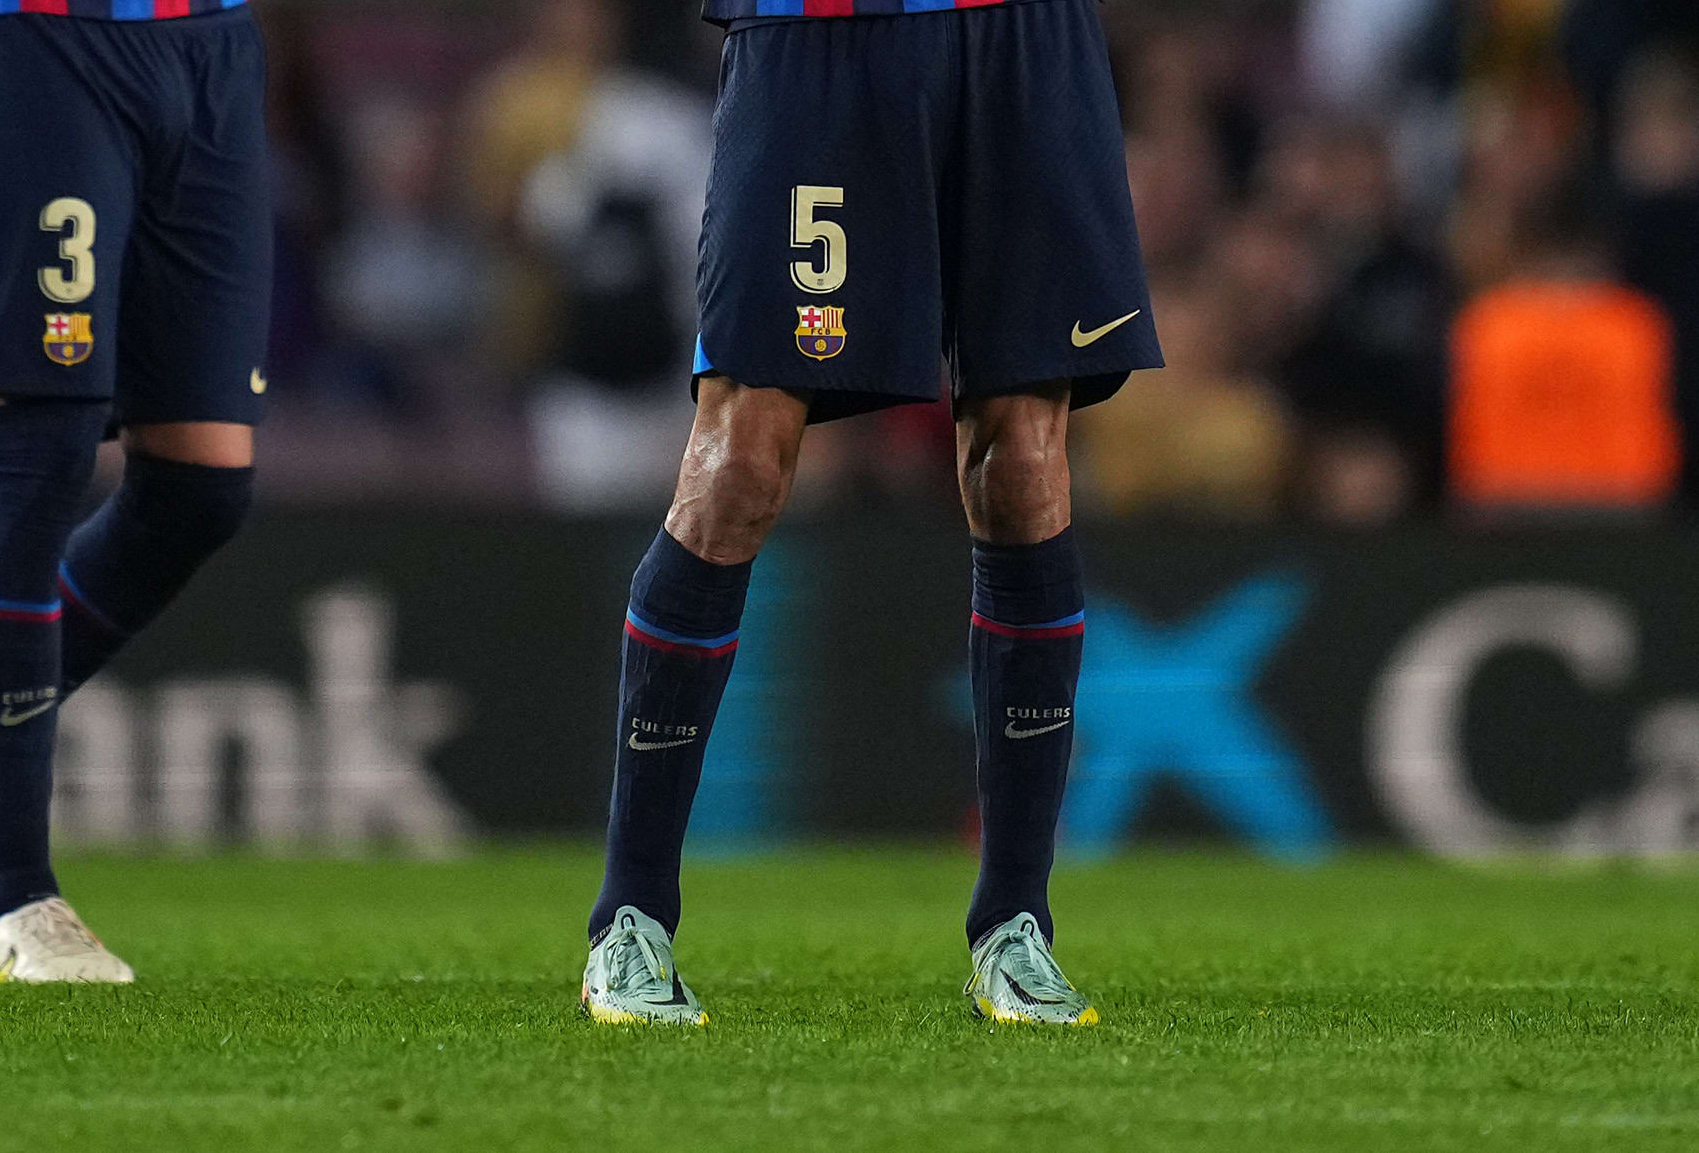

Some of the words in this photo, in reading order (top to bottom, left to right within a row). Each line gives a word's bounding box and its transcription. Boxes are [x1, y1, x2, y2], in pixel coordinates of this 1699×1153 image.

[37, 197, 97, 303] 3
[790, 185, 847, 294] 5
[1007, 707, 1071, 718] CULERS
